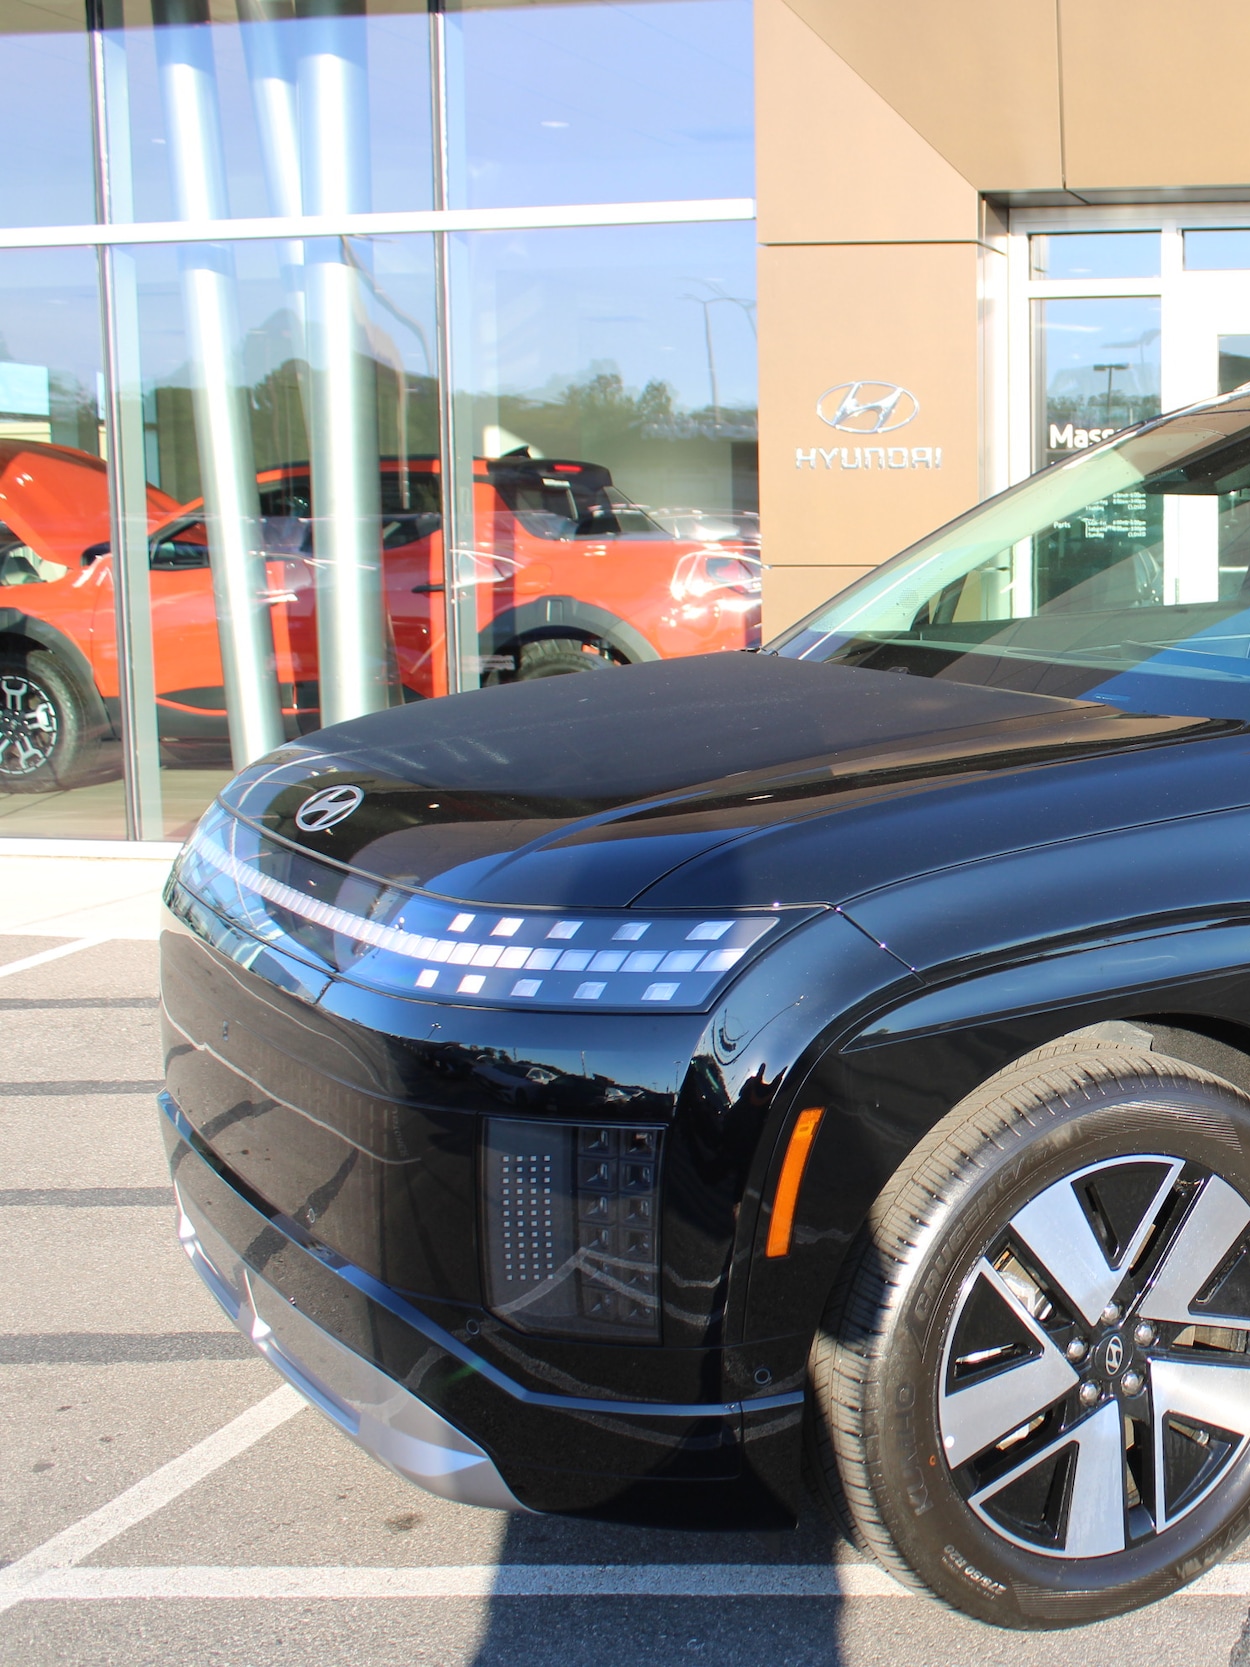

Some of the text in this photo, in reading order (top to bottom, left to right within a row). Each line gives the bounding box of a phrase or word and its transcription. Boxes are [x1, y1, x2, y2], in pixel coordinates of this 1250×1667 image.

[1049, 423, 1122, 449] Mass
[795, 447, 942, 470] HYUNDAI
[1053, 521, 1071, 529] Parts
[914, 1181, 999, 1321] CRUGEN
[896, 1383, 933, 1515] KUMHO
[943, 1544, 967, 1569] R20
